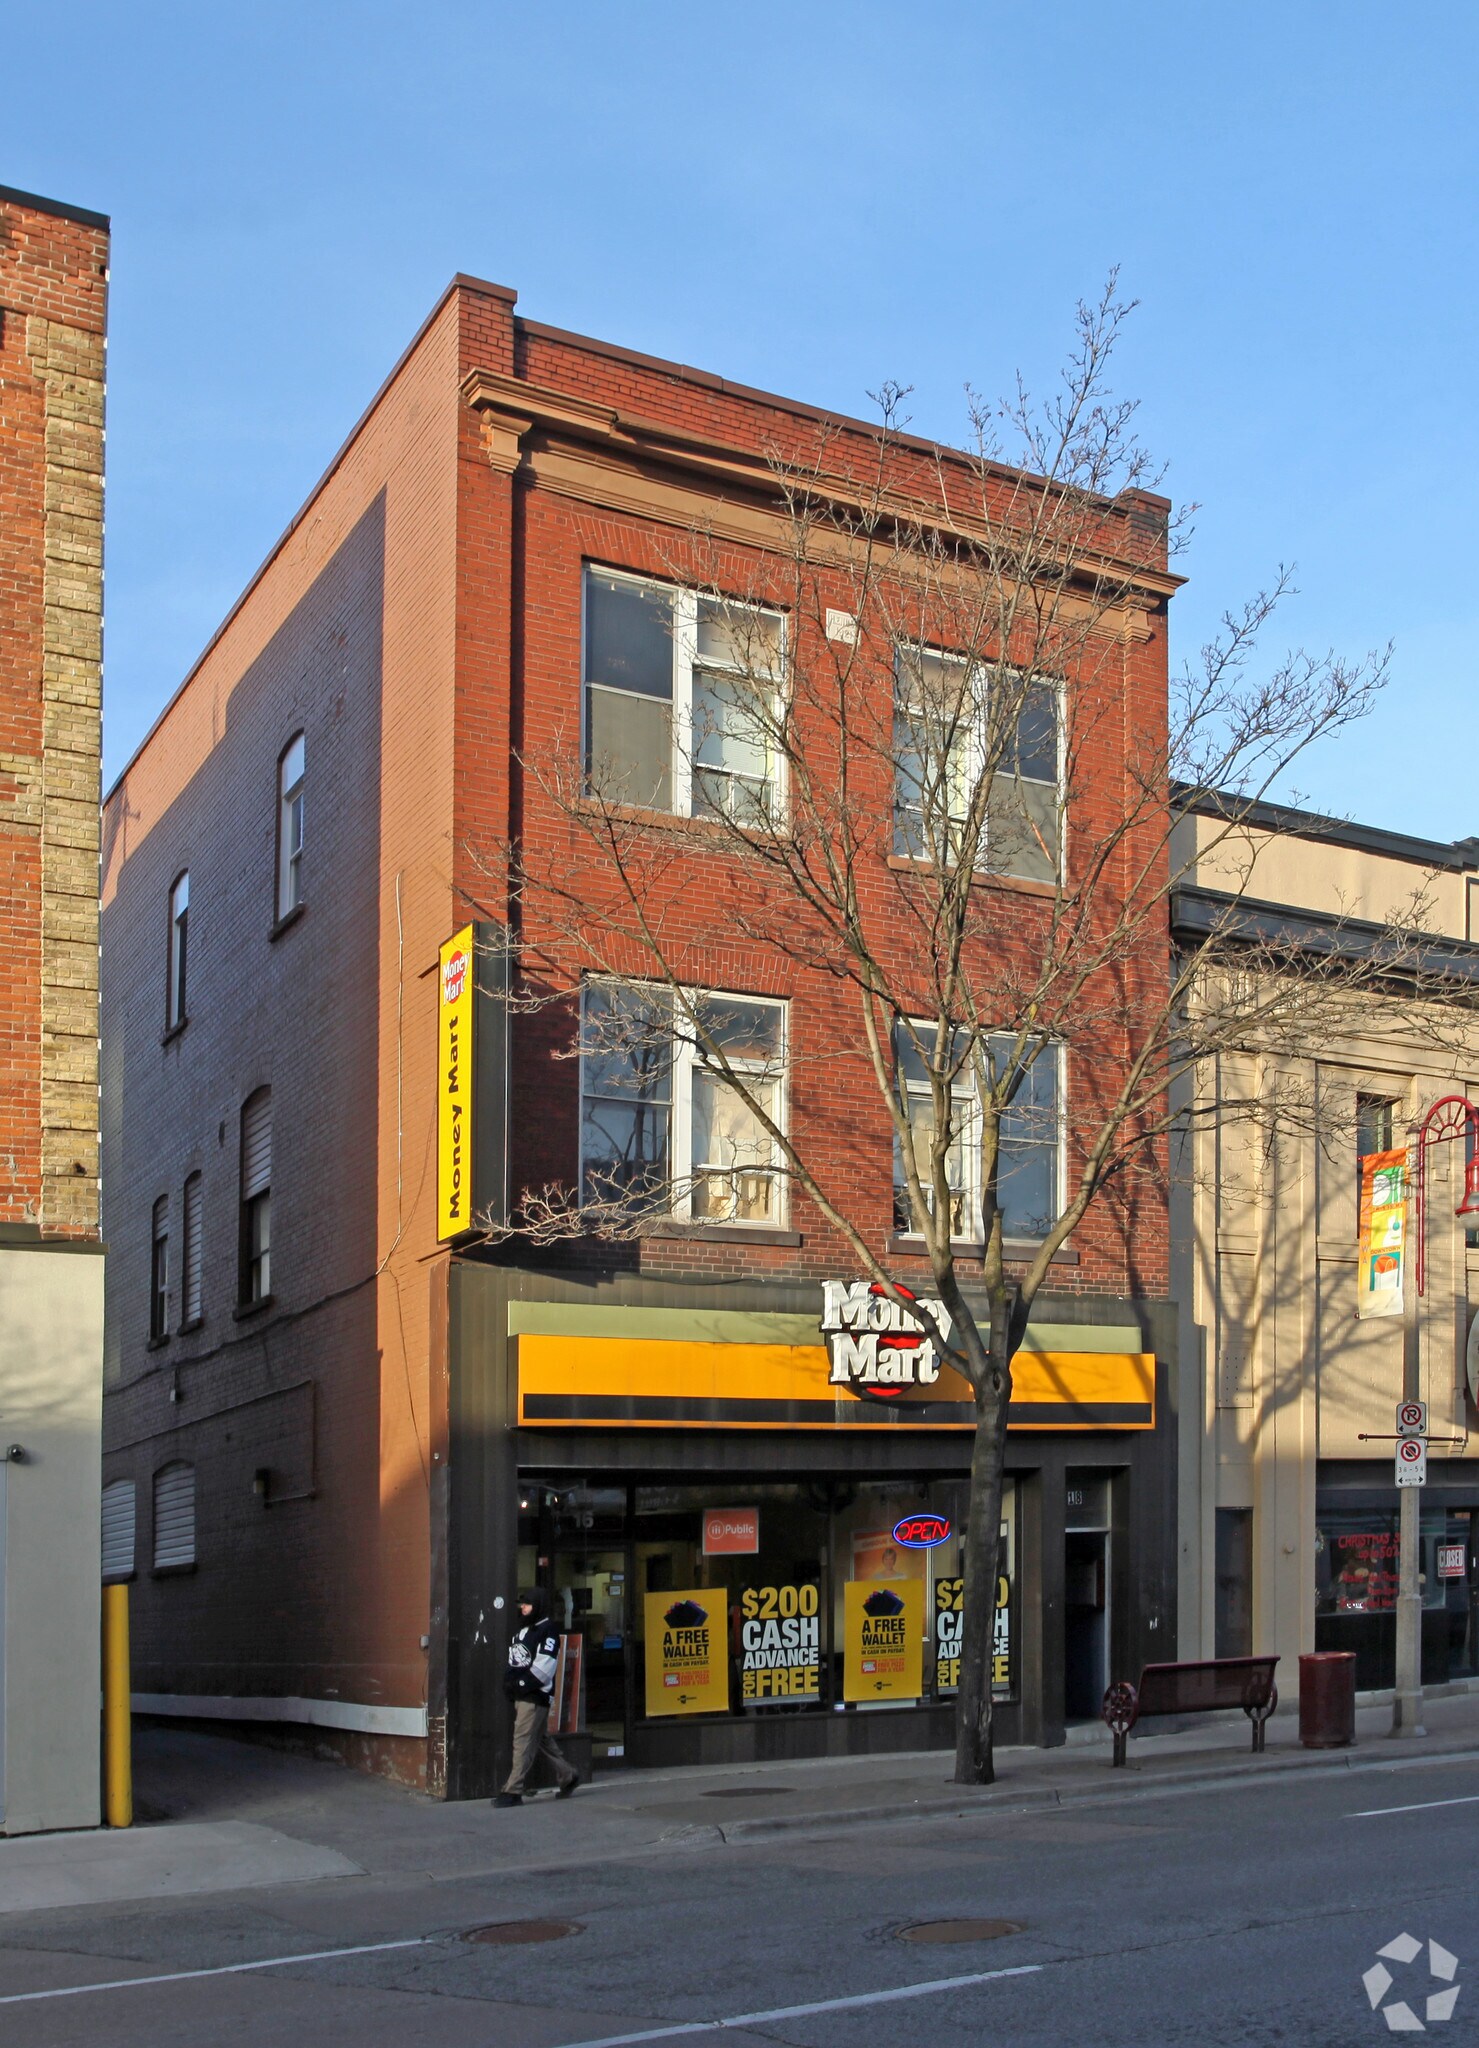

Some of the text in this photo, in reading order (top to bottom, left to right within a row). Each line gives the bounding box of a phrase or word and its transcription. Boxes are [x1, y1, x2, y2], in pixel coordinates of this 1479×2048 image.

[442, 951, 470, 985] Money
[444, 976, 464, 1006] Mart
[449, 1015, 463, 1218] Money Mart
[1370, 1246, 1401, 1254] DOWNTOWN
[830, 1332, 940, 1384] Mart
[726, 1524, 754, 1534] Public
[896, 1520, 950, 1540] OPEN
[1440, 1550, 1463, 1568] CLOSED
[742, 1584, 818, 1620] $200
[937, 1577, 1008, 1610] $20
[663, 1629, 709, 1645] A FREE
[742, 1617, 818, 1651] CASH
[862, 1618, 905, 1633] A FREE
[937, 1608, 1008, 1641] CH
[663, 1644, 709, 1658] WALLET
[862, 1632, 905, 1646] WALLET
[938, 1638, 1008, 1660] ADCE
[743, 1647, 818, 1670] ADVANCE
[937, 1656, 1009, 1687] FOR FE
[743, 1666, 819, 1698] FOR FREE
